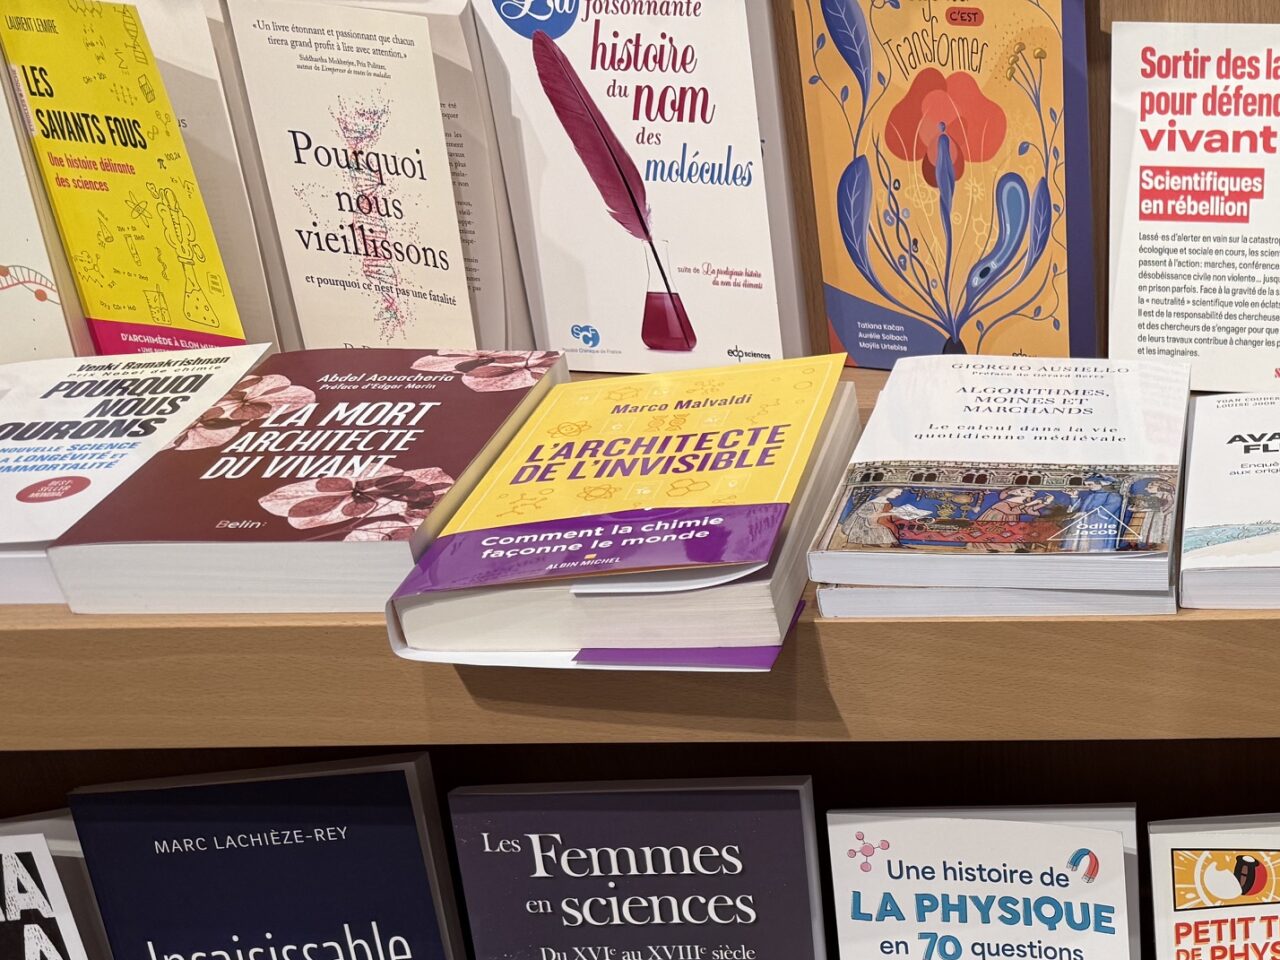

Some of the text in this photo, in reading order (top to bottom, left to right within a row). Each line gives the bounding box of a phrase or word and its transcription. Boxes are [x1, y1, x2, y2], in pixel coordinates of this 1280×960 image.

[950, 11, 978, 22] C'EST
[590, 20, 697, 74] histoire
[884, 16, 988, 81] Transformer
[1140, 46, 1212, 80] Sortir
[1216, 48, 1261, 80] des
[24, 66, 54, 98] LES
[607, 80, 715, 124] du nom
[1140, 89, 1197, 121] pour
[35, 109, 147, 150] SAVANTS FOUS
[636, 127, 662, 146] des
[1140, 119, 1278, 154] vivant
[48, 152, 135, 175] Une histoire délirante
[288, 130, 427, 184] Pourquoi
[645, 143, 753, 187] molécules
[55, 175, 109, 192] des sciences
[1141, 170, 1262, 195] Scientifiques
[336, 188, 404, 219] nous
[1141, 196, 1248, 217] en rébellion
[295, 223, 450, 271] vieillissons
[77, 356, 230, 373] Venki Ramakrishnan
[40, 374, 210, 399] POURQUOI
[956, 386, 1110, 398] ALGORITHMES,
[974, 396, 1058, 405] MOINES
[84, 395, 190, 417] NOUS
[259, 401, 441, 428] LA MORT
[610, 393, 752, 416] Marco Malvaldi
[962, 405, 1094, 415] MARCHANDS
[220, 429, 423, 454] ARCHITECTE
[525, 424, 793, 465] L'ARCHITECTE
[199, 455, 396, 480] DU VIVANT
[508, 445, 788, 487] DE L'INVISIBLE
[154, 826, 348, 854] MARC LACHIÈZE-REY
[481, 833, 743, 879] Les Femmes
[887, 860, 1070, 887] Une histoire de
[526, 881, 758, 926] en sciences
[850, 890, 1116, 935] LA PHYSIQUE
[1174, 917, 1254, 945] PETIT
[880, 940, 909, 956] en
[918, 932, 962, 960] 70
